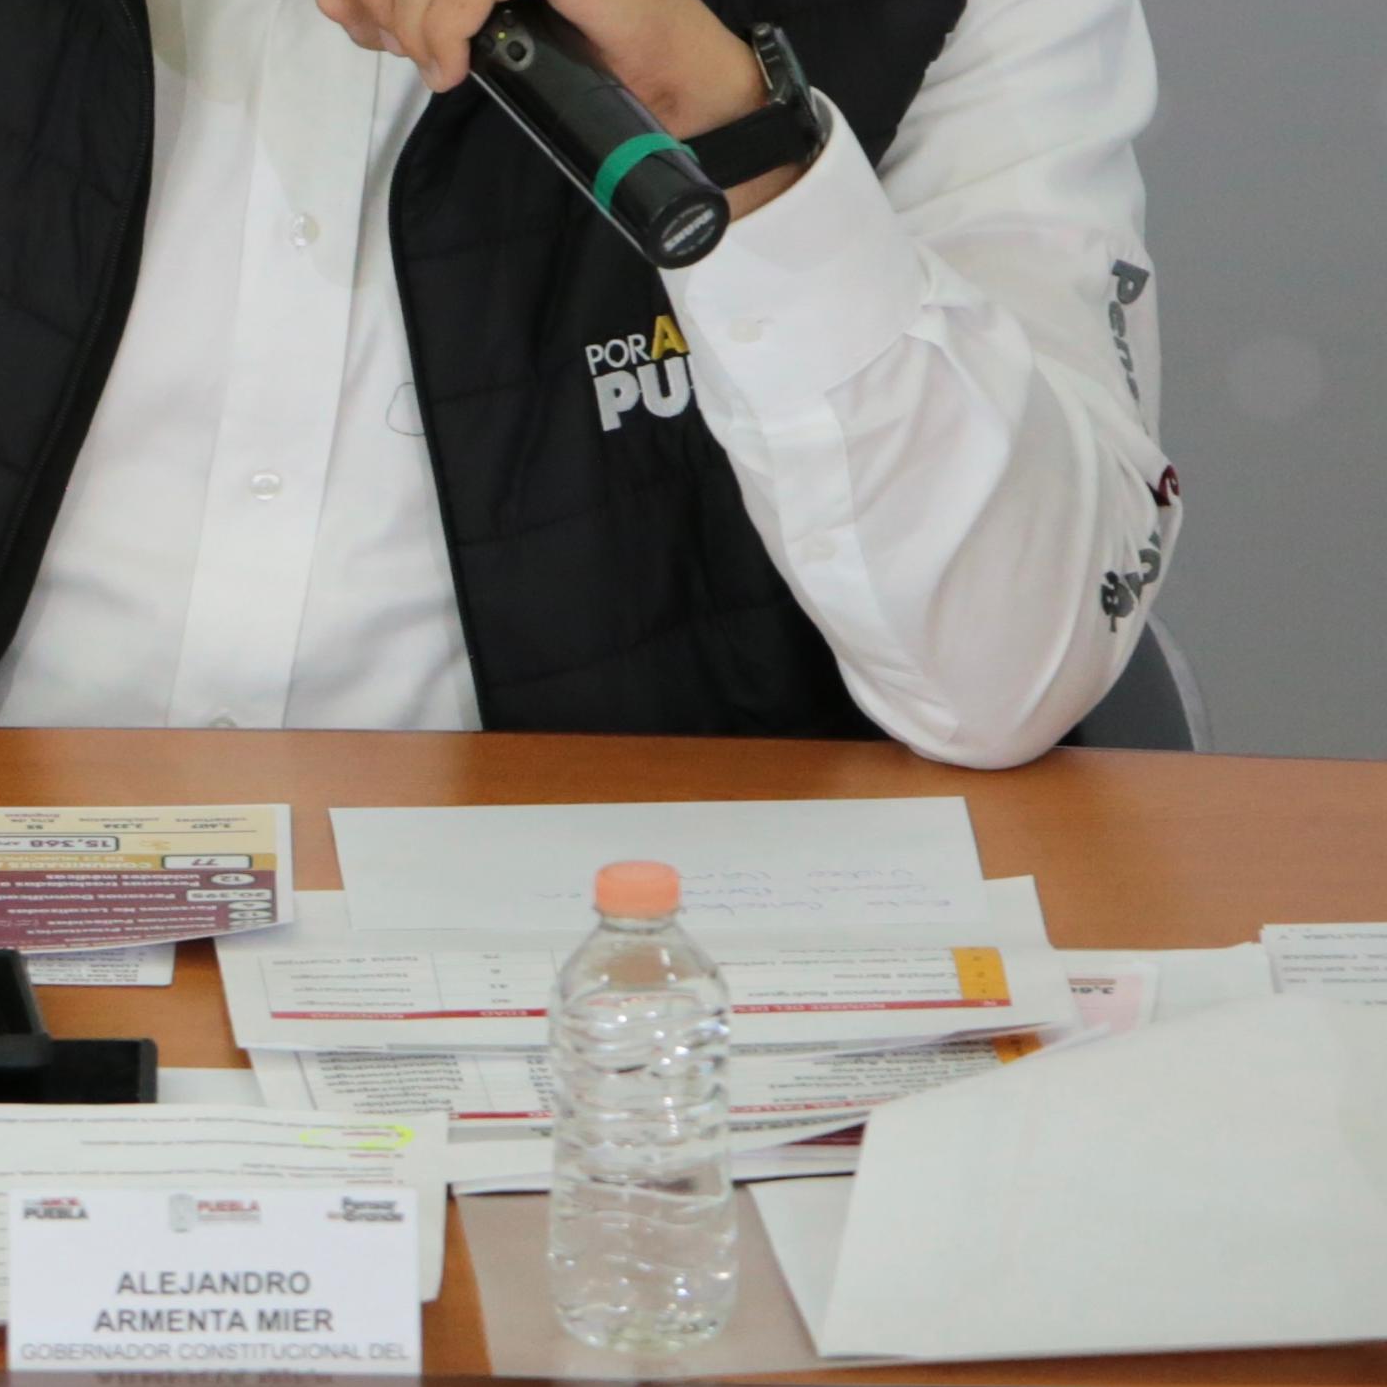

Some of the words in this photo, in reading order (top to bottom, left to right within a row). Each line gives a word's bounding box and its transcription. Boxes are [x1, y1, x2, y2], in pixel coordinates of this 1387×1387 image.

[585, 330, 650, 376] POR
[591, 352, 699, 433] PU
[23, 1204, 89, 1220] PUEBLA
[196, 1198, 262, 1214] PUEBLA
[116, 1270, 312, 1296] ALEJANDRO
[93, 1308, 247, 1333] ARMENTA
[256, 1307, 335, 1332] MIER
[20, 1342, 172, 1362] GOBERNADOR
[177, 1342, 362, 1362] CONSTITUCIONAL
[367, 1343, 410, 1361] DEL
